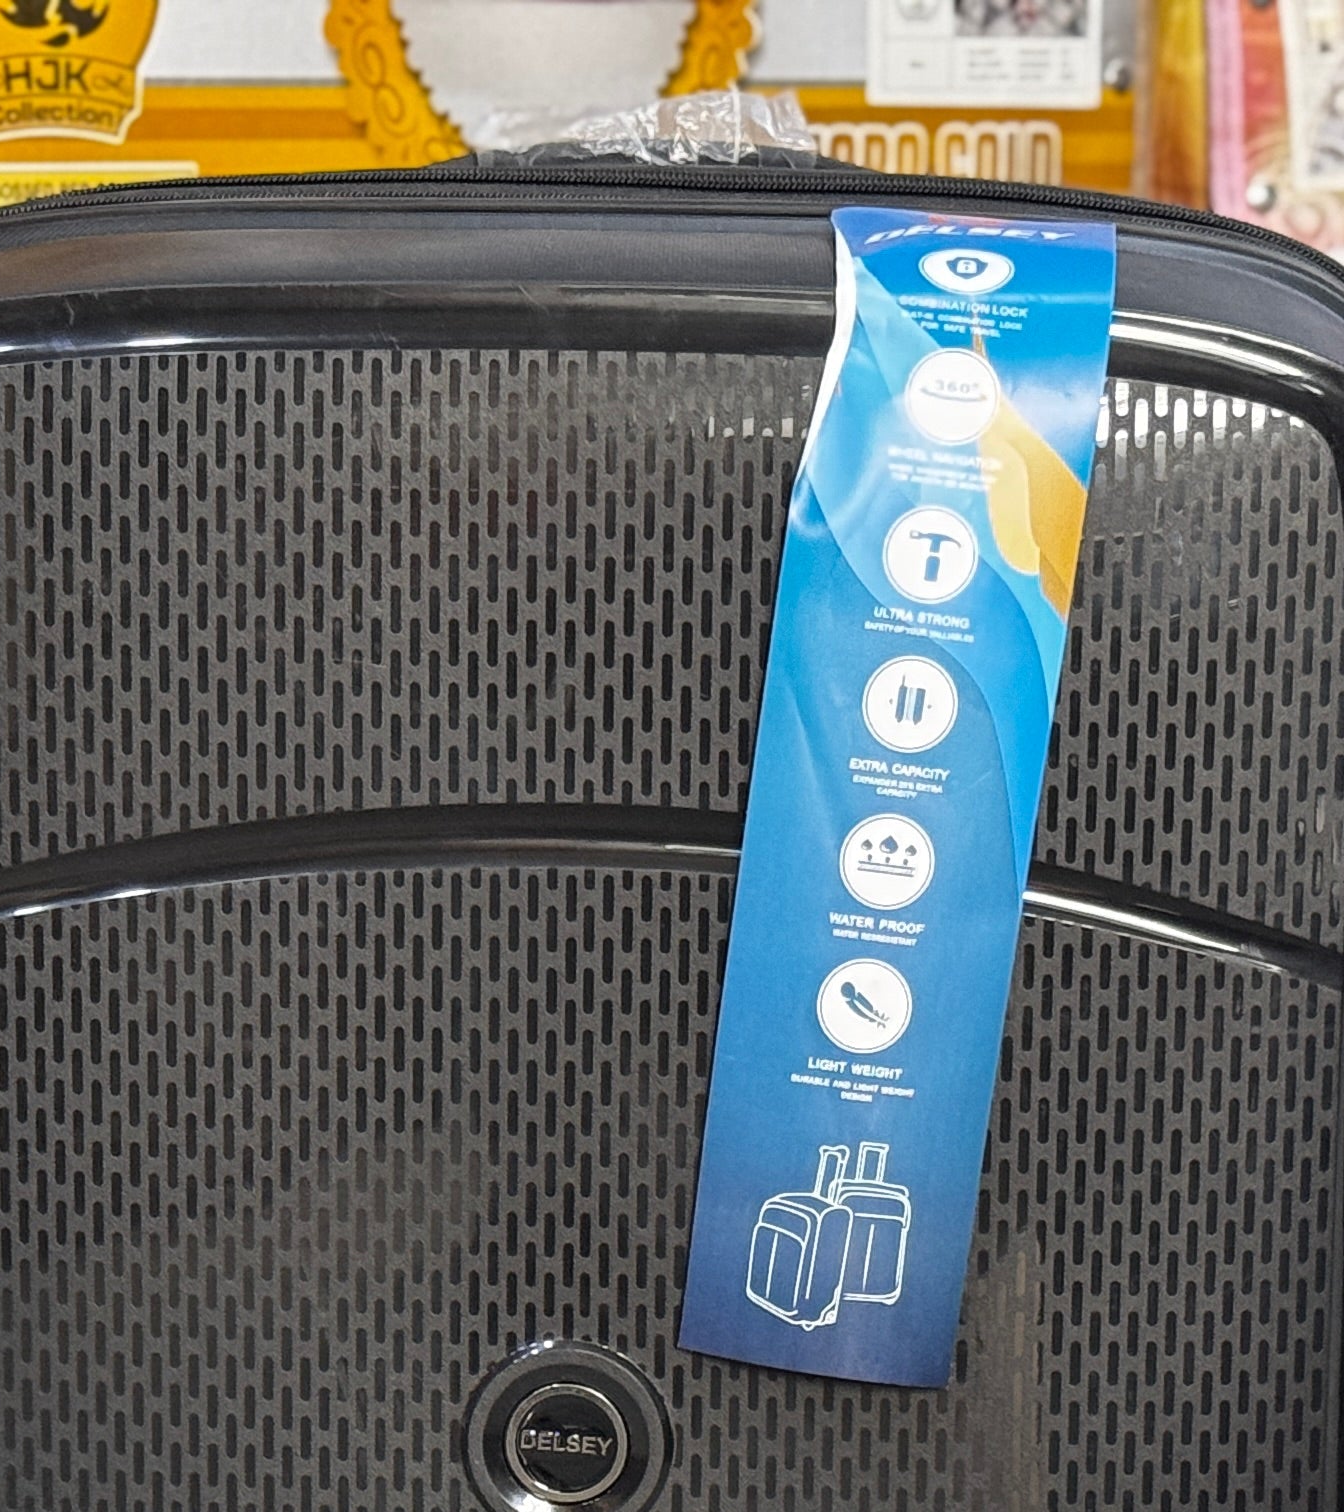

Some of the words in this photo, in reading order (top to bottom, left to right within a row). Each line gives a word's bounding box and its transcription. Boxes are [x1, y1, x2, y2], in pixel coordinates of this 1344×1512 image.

[4, 60, 92, 93] HJK
[864, 224, 1076, 246] DELSEY
[898, 295, 990, 315] COMBINATION
[992, 304, 1030, 319] LOCK
[873, 605, 913, 622] ULTRA
[917, 611, 971, 630] STRONG
[849, 757, 889, 775] EXTRA
[891, 763, 951, 781] CAPACITY
[829, 911, 875, 930] WATER
[878, 918, 926, 935] PROOF
[807, 1056, 849, 1074] LIGHT
[851, 1062, 904, 1081] WEIGHT
[520, 1429, 613, 1457] DELSEY
